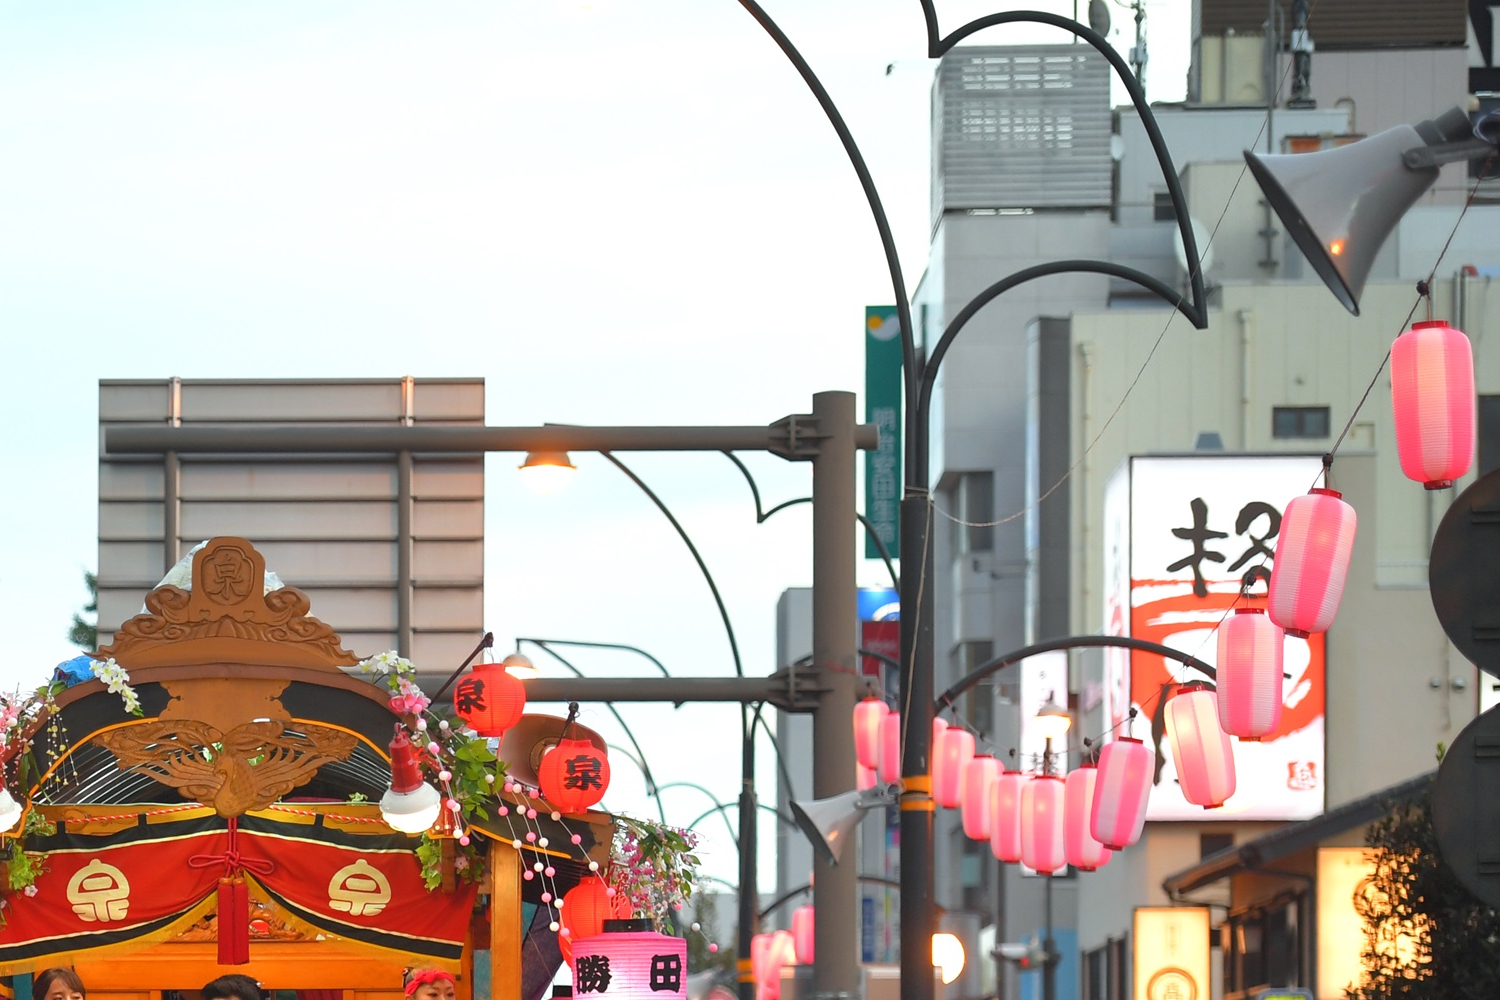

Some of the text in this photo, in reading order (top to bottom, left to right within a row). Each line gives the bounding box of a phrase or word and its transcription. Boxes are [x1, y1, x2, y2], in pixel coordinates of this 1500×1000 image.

[212, 557, 249, 599] 泉
[458, 679, 486, 714] 泉
[564, 755, 603, 790] 泉
[576, 954, 681, 994] 勝田
